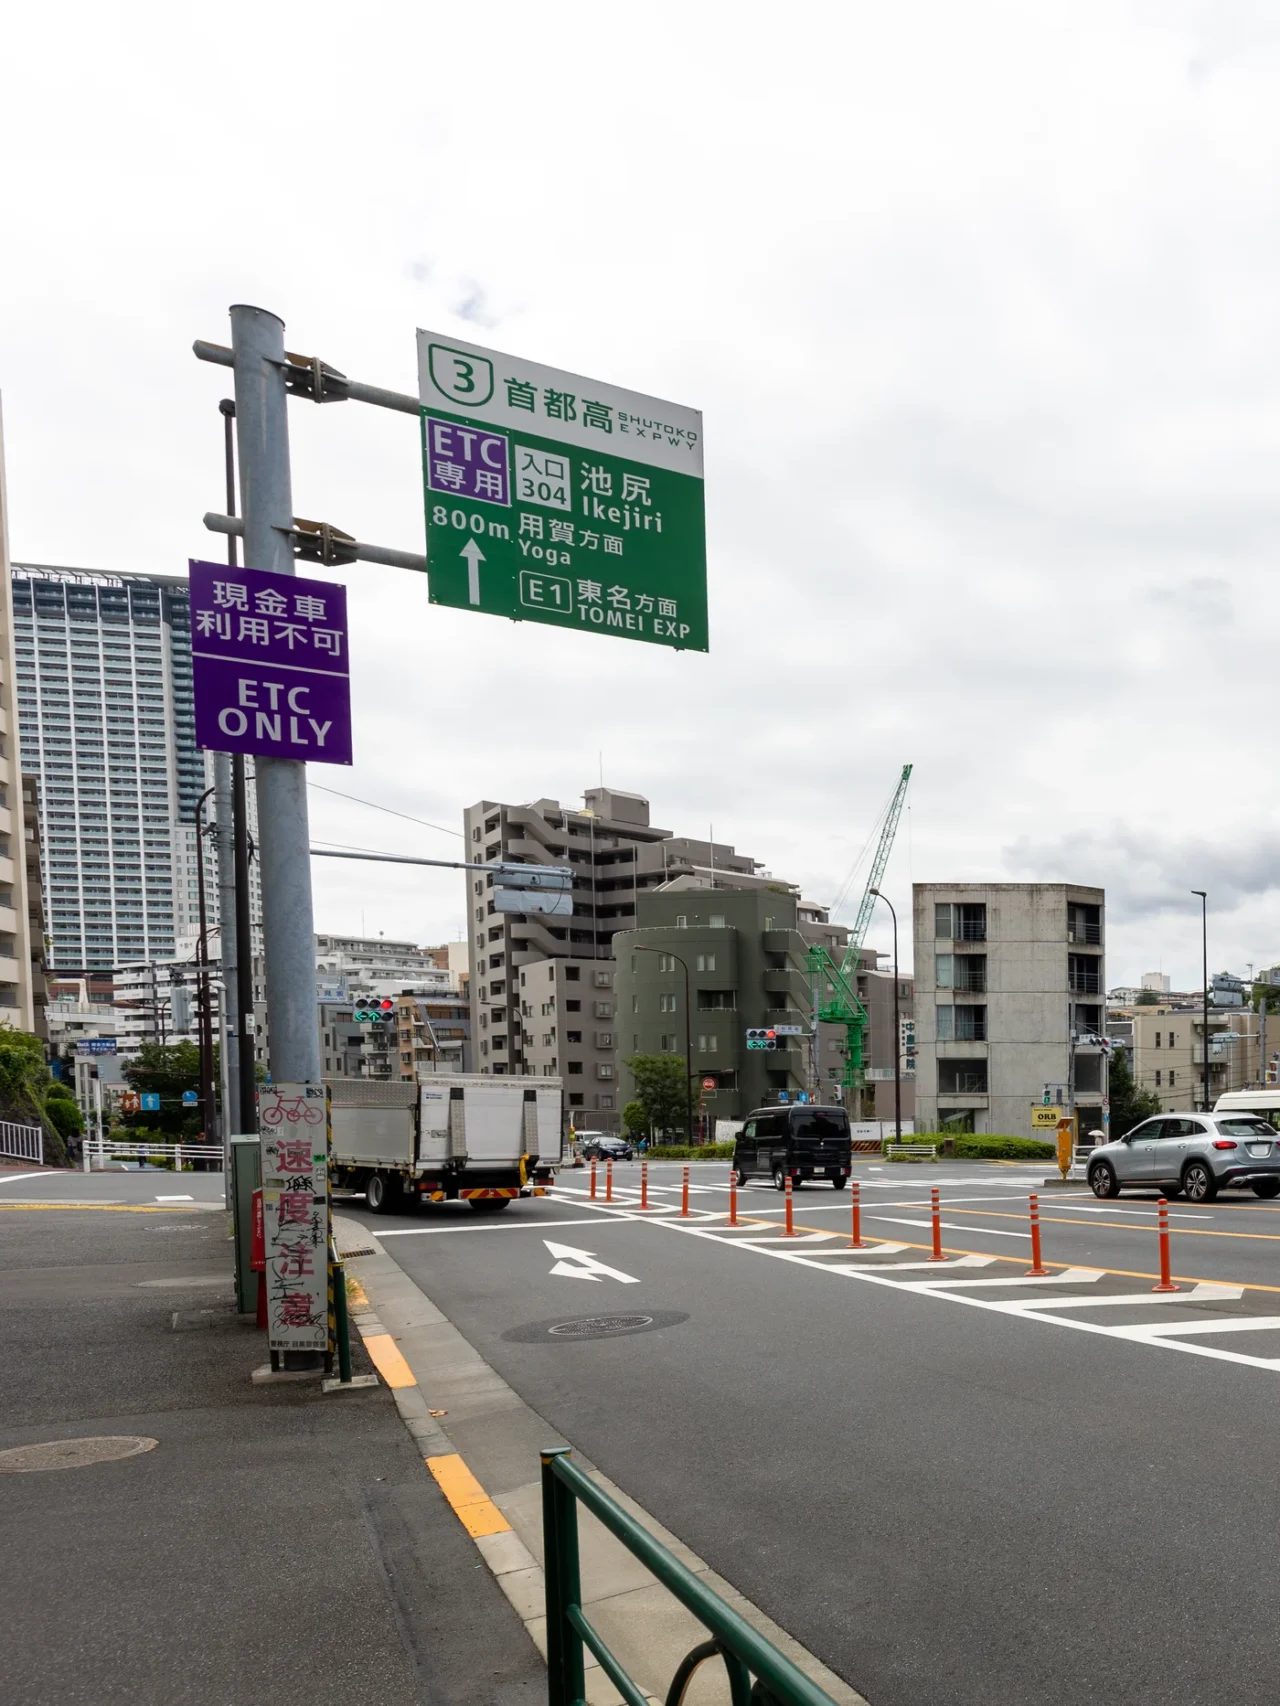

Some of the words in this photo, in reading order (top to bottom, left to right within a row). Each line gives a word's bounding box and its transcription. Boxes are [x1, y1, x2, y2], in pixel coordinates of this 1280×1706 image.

[452, 358, 476, 394] 3
[503, 377, 613, 434] 首都高
[617, 411, 698, 441] SHUTOKO
[620, 423, 697, 451] EXPWY
[433, 424, 502, 468] ETC
[433, 460, 503, 500] 専用
[521, 452, 565, 481] 入口
[580, 461, 653, 507] 池尻
[521, 477, 567, 505] 304
[432, 505, 510, 540] 800m
[582, 496, 663, 533] Ikejiri
[518, 512, 624, 556] 用賀方面
[518, 538, 572, 566] Yoga
[212, 580, 328, 623] 現金車
[529, 579, 562, 605] E1
[576, 578, 677, 618] 東名方面
[196, 609, 344, 657] 利用不可
[577, 604, 644, 632] TOMEI
[653, 615, 691, 640] EXP
[238, 678, 311, 715] ETC
[218, 707, 333, 747] ONLY
[275, 1139, 314, 1327] 速度注意
